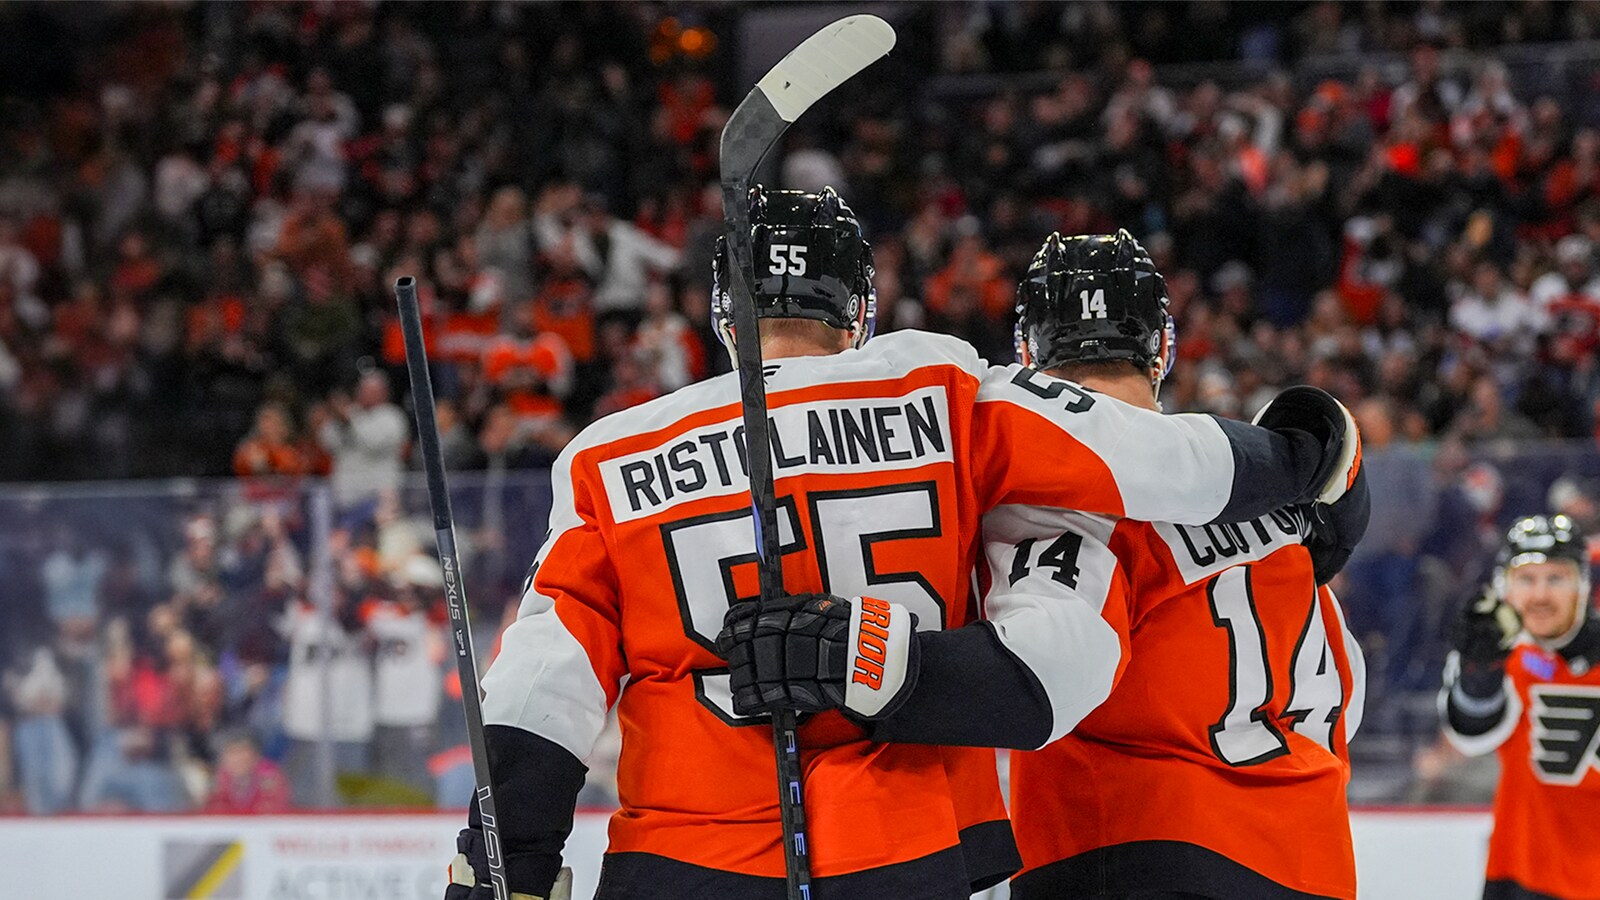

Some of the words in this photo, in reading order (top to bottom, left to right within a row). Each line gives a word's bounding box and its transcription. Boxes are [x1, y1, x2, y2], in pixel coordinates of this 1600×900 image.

[769, 244, 807, 276] 55
[1079, 288, 1107, 320] 14
[1010, 367, 1103, 413] 5
[442, 557, 461, 621] NEXUS
[1009, 531, 1082, 591] 14
[659, 480, 947, 727] 55
[1206, 564, 1343, 767] 14
